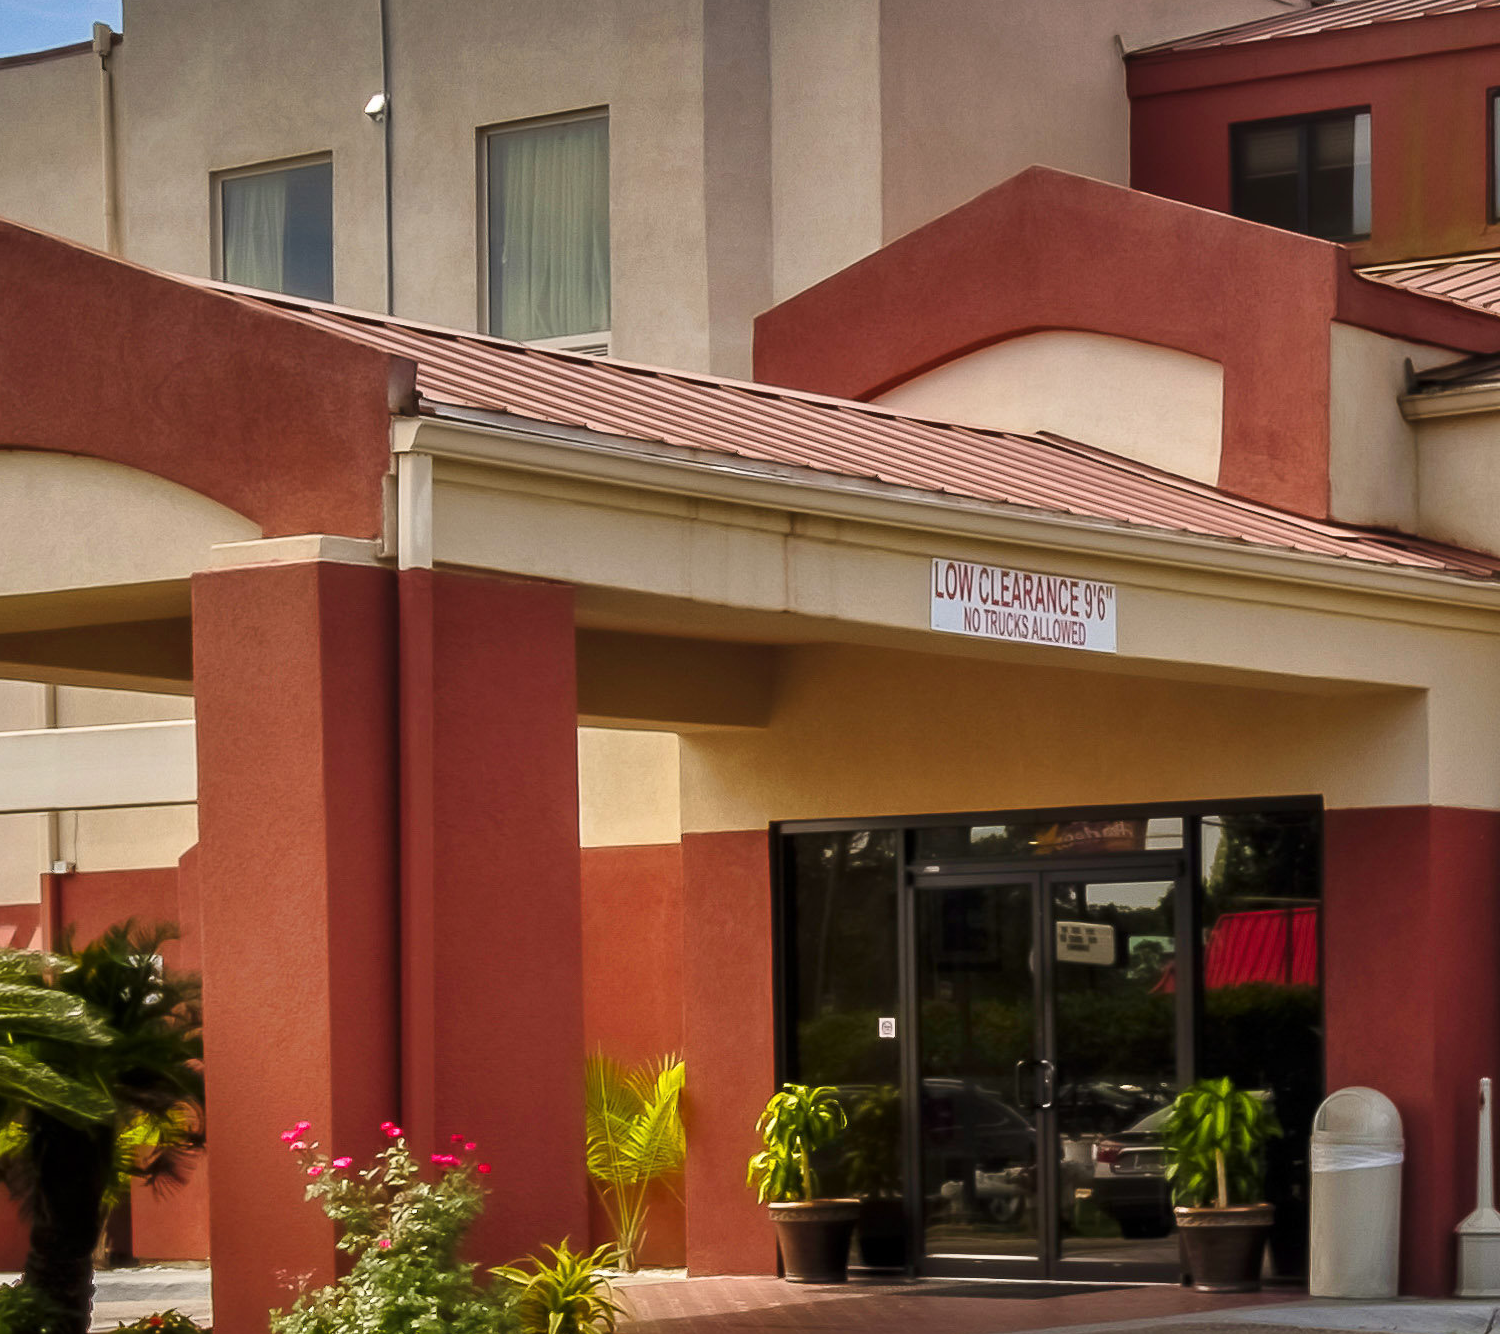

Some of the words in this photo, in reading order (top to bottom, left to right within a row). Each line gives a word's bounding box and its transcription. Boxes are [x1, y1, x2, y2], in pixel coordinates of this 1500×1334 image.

[934, 561, 974, 602] LOW
[979, 568, 1079, 617] CLEARANCE
[1084, 583, 1113, 621] 9'6"
[964, 606, 980, 633] NO
[984, 609, 1029, 639] TRUCKS
[1031, 616, 1086, 646] ALLOWED
